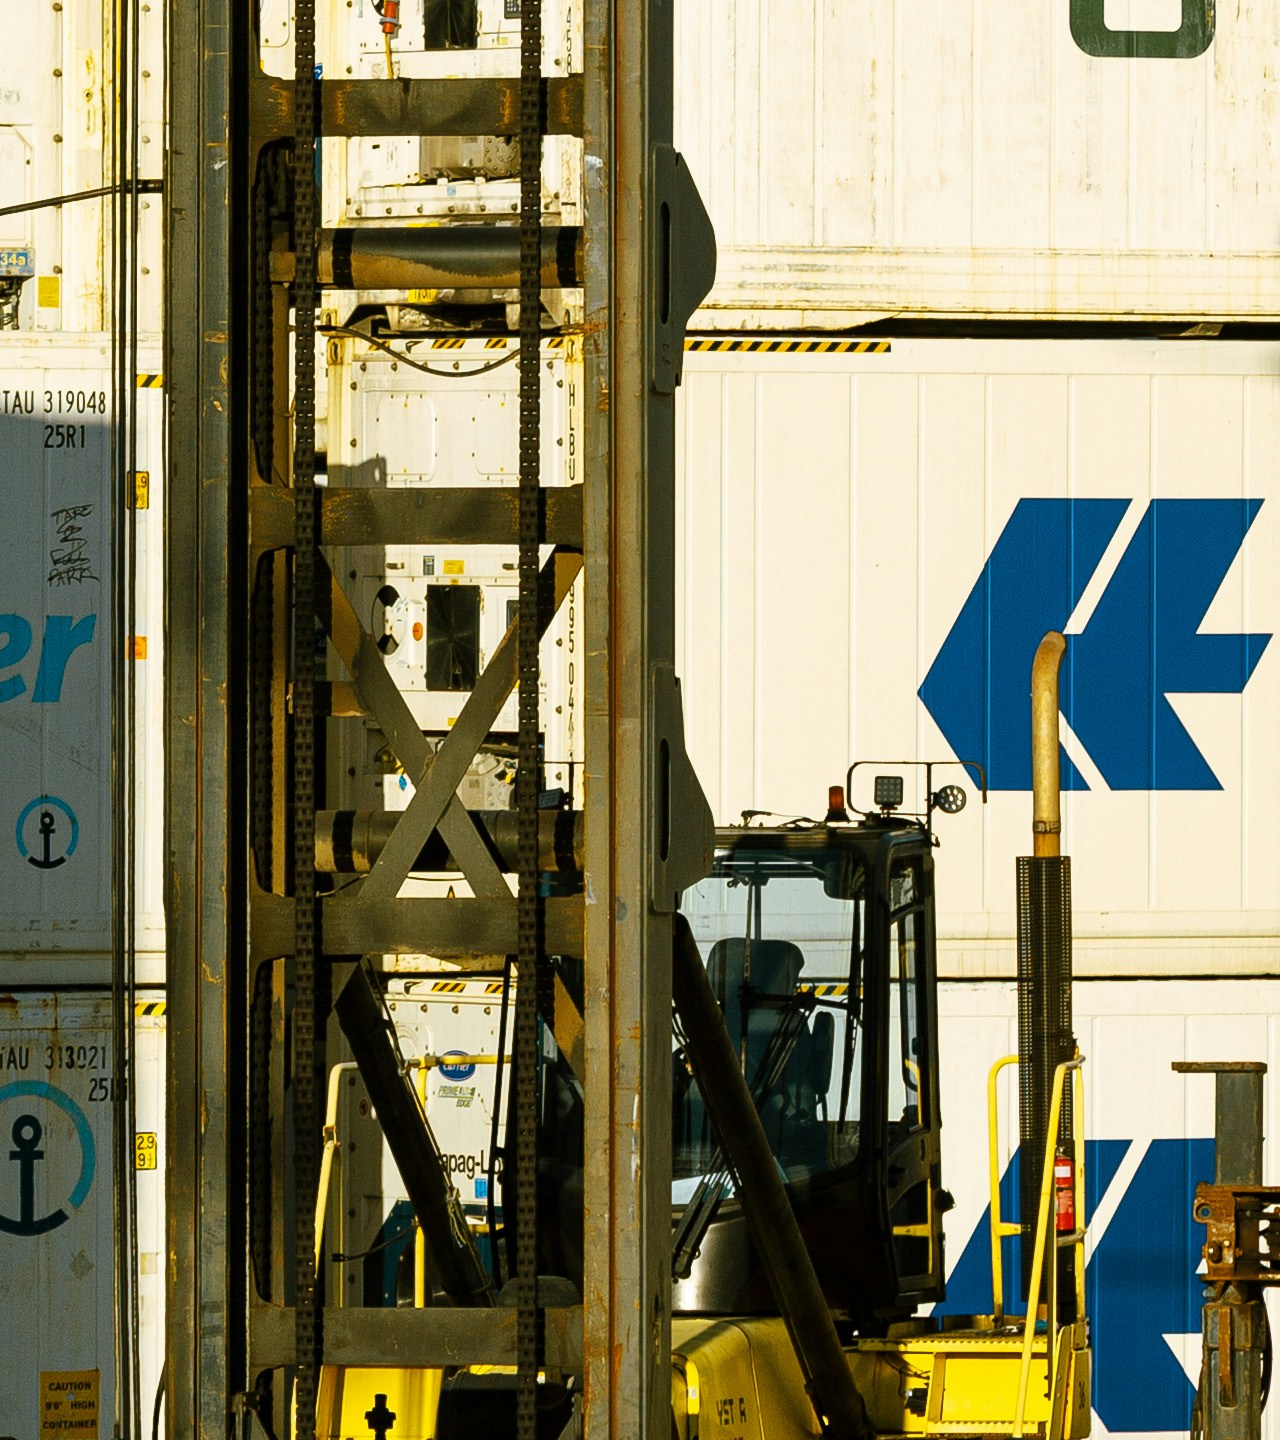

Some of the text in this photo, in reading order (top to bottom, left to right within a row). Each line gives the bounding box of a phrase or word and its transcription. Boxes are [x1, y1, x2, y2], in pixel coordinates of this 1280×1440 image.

[42, 390, 107, 416] 319048
[44, 424, 87, 449] 25R1
[48, 1380, 92, 1393] CAUTION
[70, 1399, 97, 1411] HIGH
[42, 1418, 98, 1431] CONTAINER
